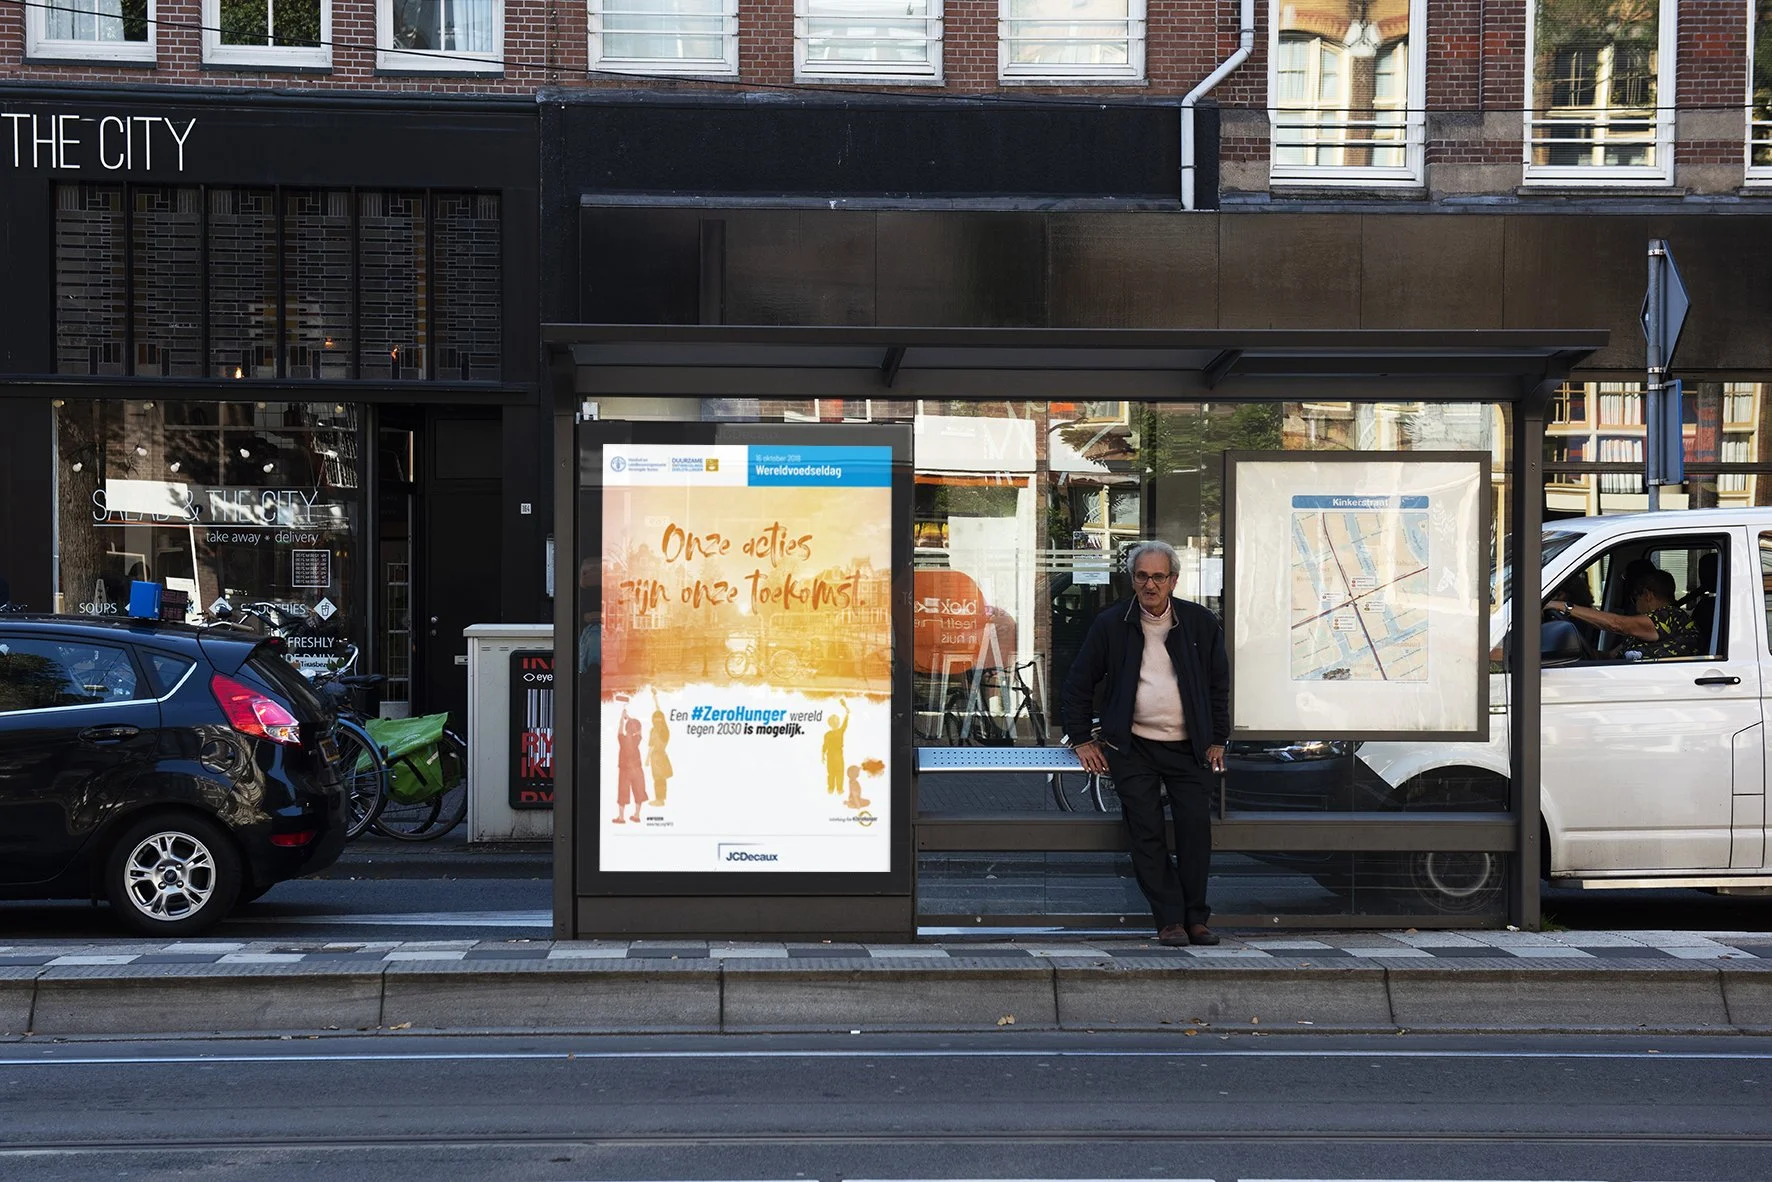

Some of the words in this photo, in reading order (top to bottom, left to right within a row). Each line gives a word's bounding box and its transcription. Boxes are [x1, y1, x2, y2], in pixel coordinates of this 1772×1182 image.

[1, 113, 80, 168] THE
[100, 116, 196, 171] CITY
[756, 465, 841, 478] Wereldvoedseldag
[206, 490, 250, 522] THE
[261, 490, 318, 522] CITY
[206, 532, 229, 543] take
[232, 535, 260, 546] away
[275, 531, 318, 546] delivery
[662, 522, 731, 562] Onze
[743, 521, 813, 567] acties
[619, 578, 671, 616] zijn
[681, 580, 738, 609] onze
[79, 602, 117, 614] SOUPS
[287, 636, 334, 648] FRESHLY
[536, 673, 553, 683] eye
[670, 709, 688, 721] Een
[691, 706, 787, 725] #ZeroHunger
[790, 710, 823, 722] wereld
[687, 724, 714, 738] tegen
[717, 723, 742, 735] 2030
[744, 723, 753, 735] is
[756, 723, 805, 738] mogelijk.
[726, 852, 778, 861] JCDecaux
